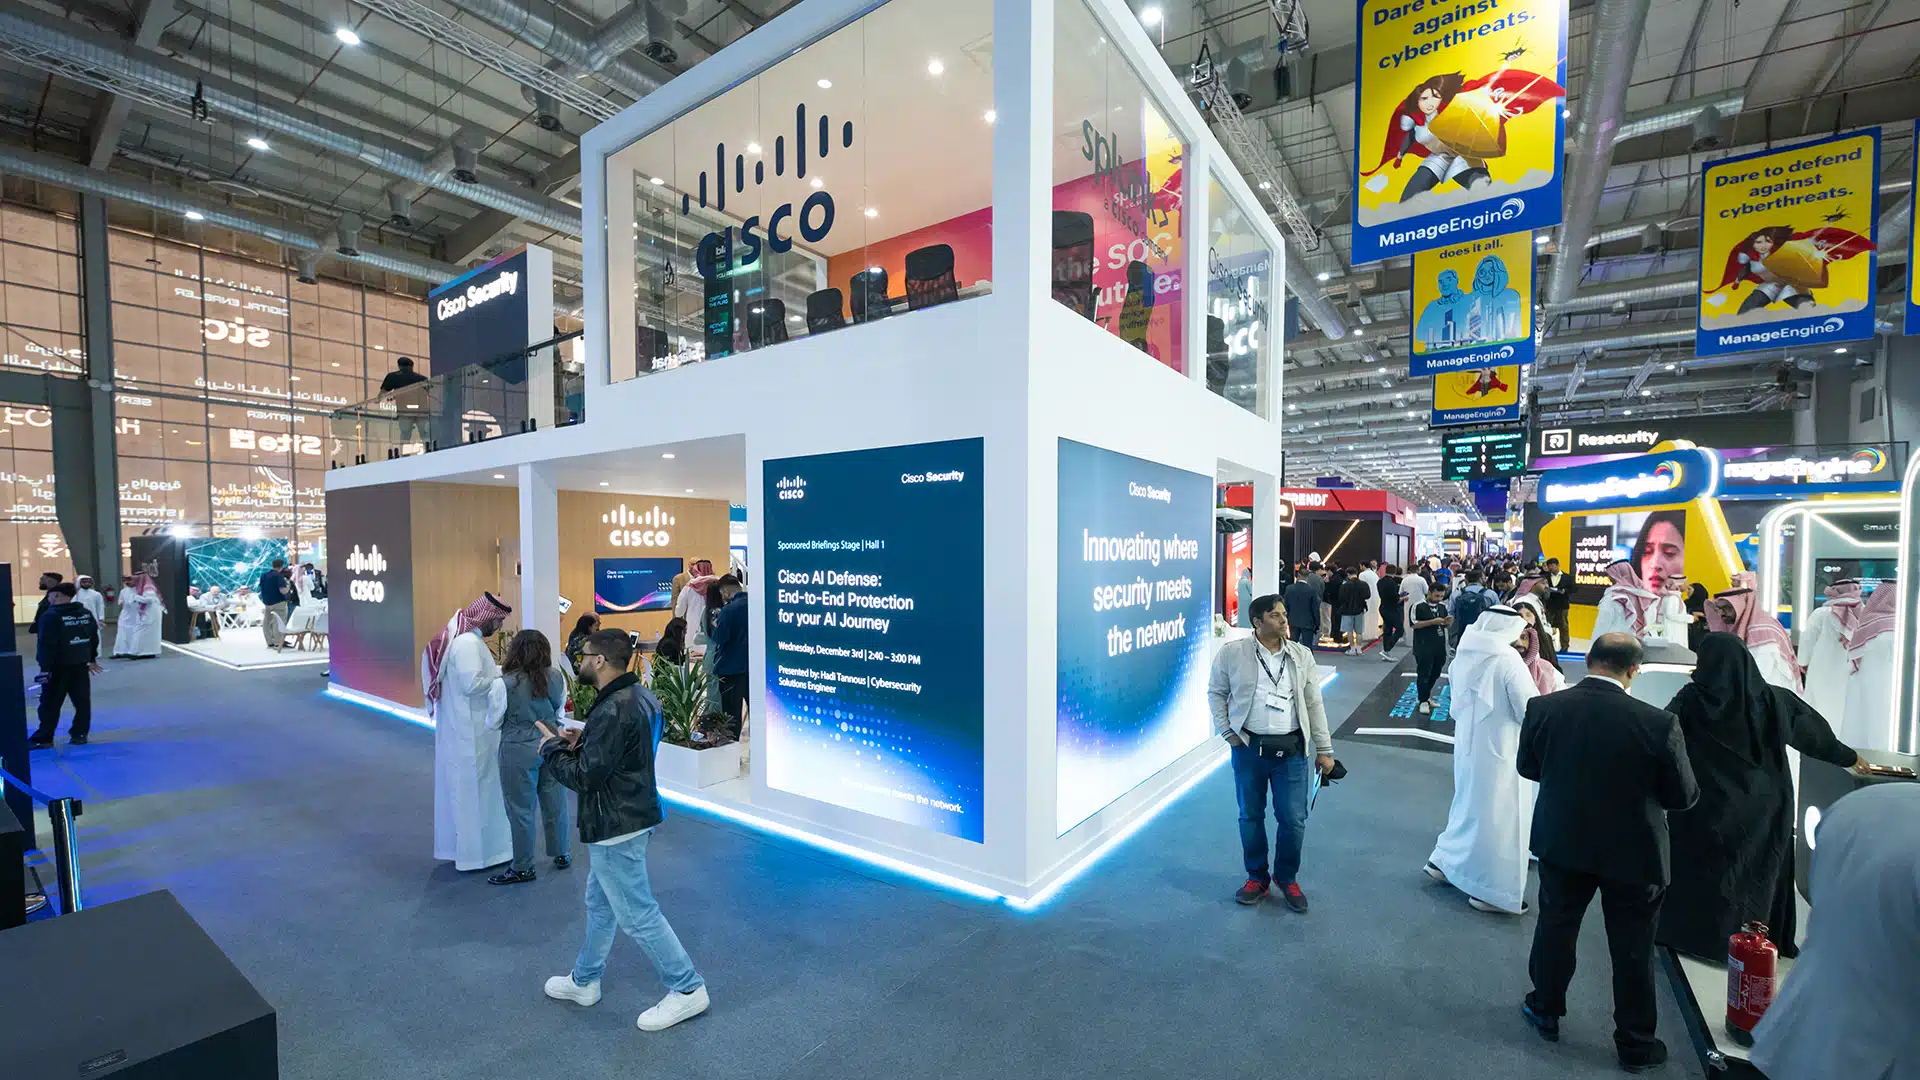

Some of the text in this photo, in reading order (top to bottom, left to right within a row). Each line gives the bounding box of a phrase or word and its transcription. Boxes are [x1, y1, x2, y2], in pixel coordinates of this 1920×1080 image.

[1374, 0, 1425, 26] Dare
[1413, 0, 1499, 36] against
[1379, 10, 1537, 70] cyberthreats.
[1715, 147, 1863, 188] Dare to defend
[1749, 173, 1823, 198] against
[1719, 186, 1854, 220] cyberthreats.
[696, 190, 836, 279] CISCO
[1379, 207, 1514, 248] ManageEngine
[1439, 239, 1504, 260] does it all.
[437, 270, 520, 321] Cisco Security
[1719, 322, 1836, 346] ManageEngine
[1427, 349, 1509, 369] ManageEngine
[1443, 409, 1502, 421] ManageEngine
[1578, 430, 1659, 448] Resecurity
[901, 470, 965, 484] Cisco Security
[779, 487, 804, 501] CISCO
[1128, 481, 1171, 504] Cisco Security
[609, 529, 671, 548] CISCO
[1863, 523, 1892, 532] Smart
[777, 540, 811, 551] Sponsored
[811, 540, 840, 552] Briefings
[840, 540, 860, 552] Stage
[865, 539, 880, 550] Hall
[1083, 528, 1199, 568] Innovating where
[1575, 549, 1600, 563] bring
[777, 569, 882, 588] Cisco AI Defense:
[1575, 562, 1597, 574] your
[349, 579, 386, 604] CISCO
[777, 588, 914, 611] End-to-End Protection
[1093, 575, 1192, 613] security meets
[778, 608, 890, 634] for your AI Journey
[1107, 613, 1187, 658] the network
[777, 640, 816, 657] Wednesday,
[816, 643, 851, 659] December
[851, 648, 864, 660] 3rd
[868, 650, 884, 662] 2:40
[890, 652, 907, 664] 3:00
[907, 653, 921, 666] PM
[777, 665, 809, 679] Presented
[809, 668, 820, 680] by:
[820, 669, 836, 682] Hadi
[836, 671, 866, 686] Tannous
[870, 676, 922, 696] Cybersecurity
[777, 676, 837, 695] Solutions Engineer
[917, 792, 929, 806] the
[930, 799, 964, 814] network.
